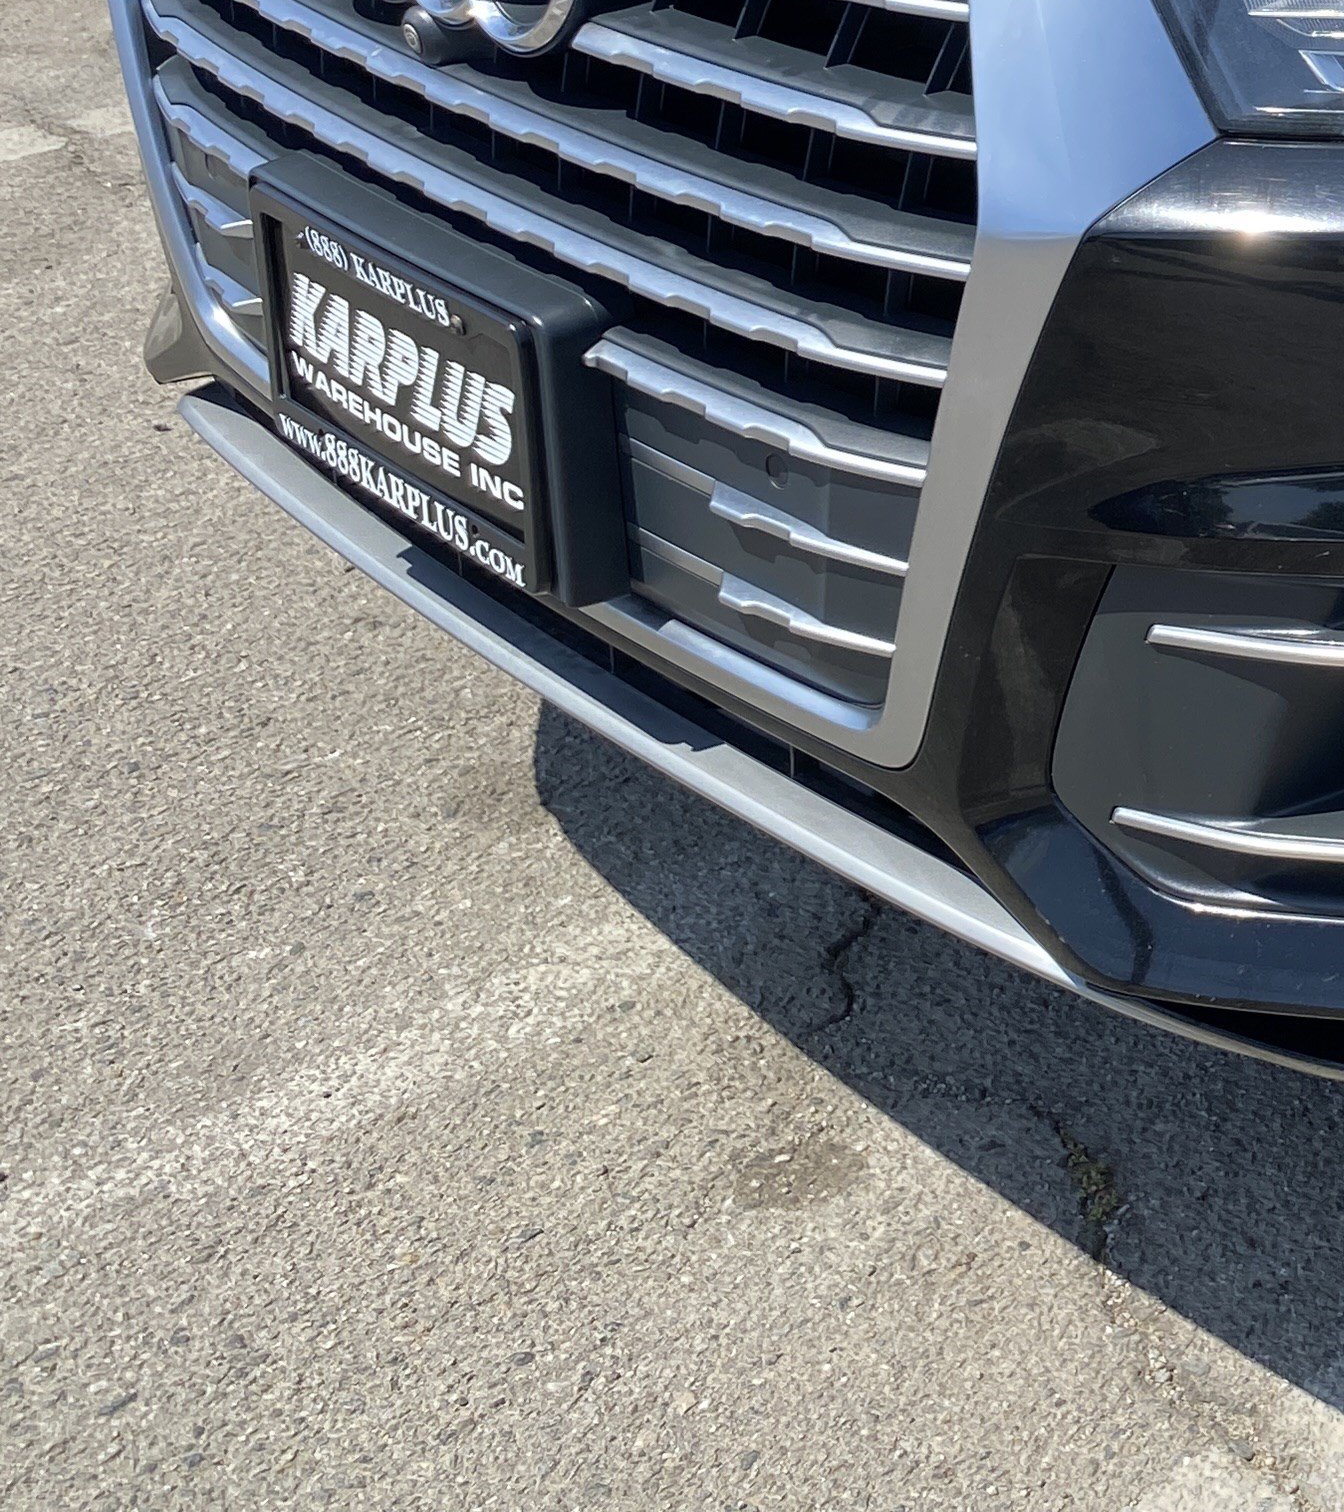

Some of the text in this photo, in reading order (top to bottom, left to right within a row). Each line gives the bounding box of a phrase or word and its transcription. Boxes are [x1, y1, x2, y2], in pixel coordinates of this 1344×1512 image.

[304, 225, 451, 327] (888) KARPLUS
[289, 272, 516, 465] KARPLUS
[290, 351, 525, 511] WAREHOUSE INC
